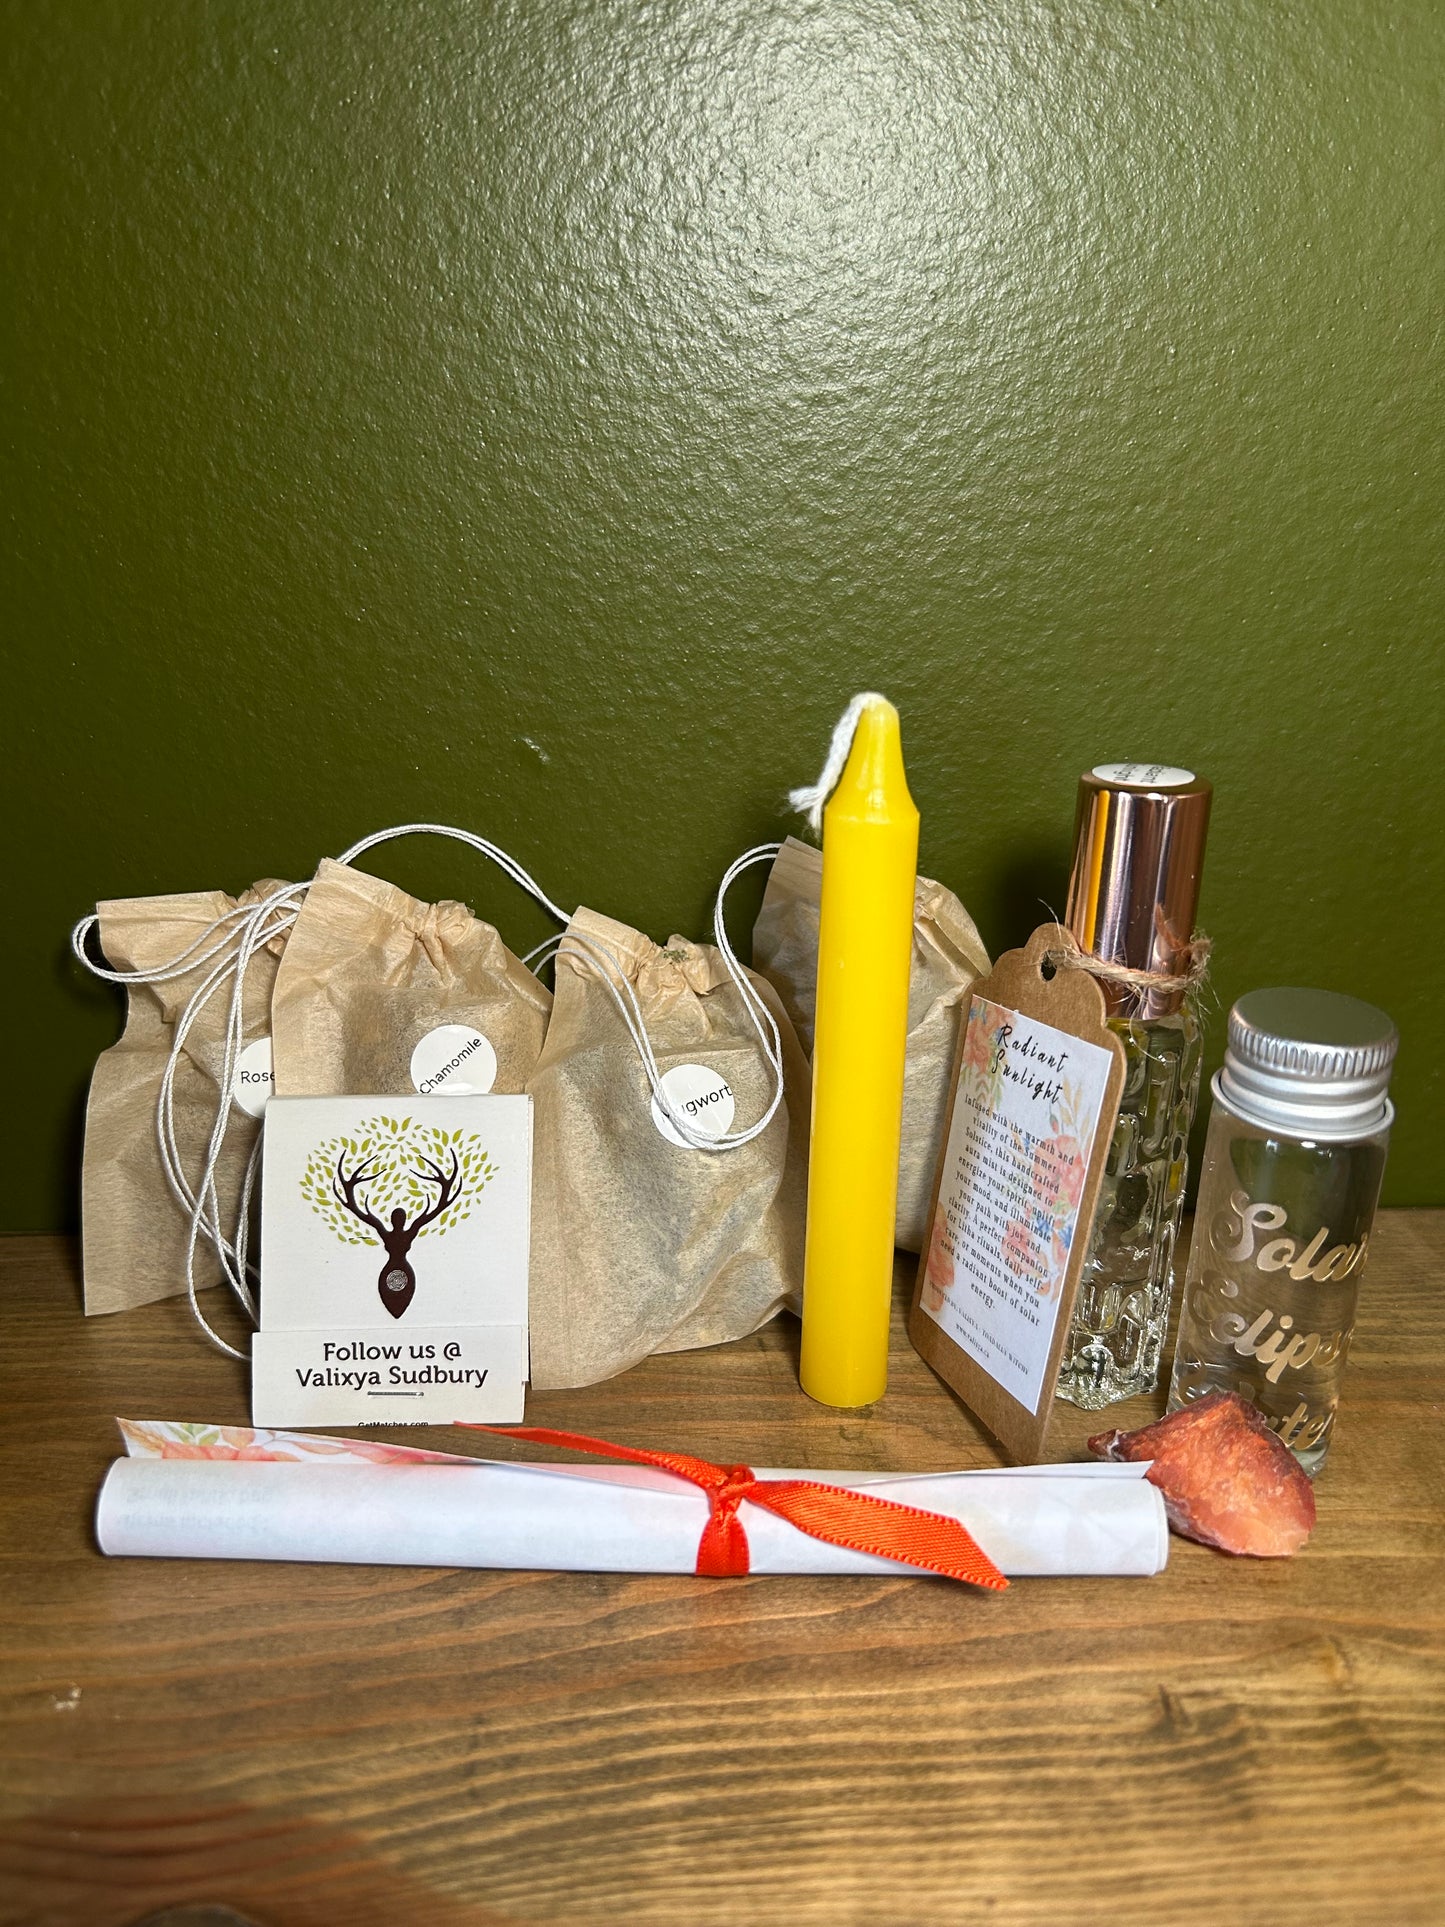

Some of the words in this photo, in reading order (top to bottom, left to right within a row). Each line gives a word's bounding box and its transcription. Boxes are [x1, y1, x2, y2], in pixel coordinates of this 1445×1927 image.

[419, 1036, 482, 1095] Chamomile
[992, 1048, 1063, 1105] Sunlight
[997, 1023, 1069, 1073] Radiant
[674, 1084, 734, 1119] gwort
[964, 1093, 990, 1116] Infused
[992, 1111, 1008, 1127] with
[1010, 1122, 1023, 1135] the
[1024, 1131, 1055, 1155] warmth
[1057, 1151, 1074, 1166] and
[973, 1116, 998, 1140] vitality
[999, 1134, 1009, 1144] of
[1009, 1138, 1022, 1152] the
[1023, 1144, 1056, 1173] Summer
[995, 1146, 1011, 1162] this
[1011, 1155, 1059, 1194] handcrafted
[958, 1156, 986, 1179] energize
[986, 1176, 1005, 1193] your
[1032, 1201, 1055, 1226] uplift
[965, 1144, 980, 1160] aura
[982, 1156, 998, 1171] mist
[999, 1165, 1006, 1177] is
[1008, 1171, 1041, 1200] designed
[1044, 1196, 1053, 1207] to
[955, 1170, 971, 1186] your
[994, 1198, 1008, 1213] and
[1010, 1205, 1052, 1243] illuminate
[958, 1189, 975, 1205] your
[975, 1201, 991, 1218] path
[993, 1214, 1010, 1232] with
[1010, 1226, 1024, 1243] joy
[1025, 1238, 1041, 1254] and
[946, 1209, 957, 1224] for
[958, 1218, 975, 1239] Litha
[1004, 1255, 1024, 1279] daily
[979, 1221, 1005, 1245] perfect
[1006, 1242, 1048, 1278] companion
[961, 1240, 969, 1251] or
[970, 1248, 1001, 1277] moments
[1003, 1273, 1023, 1295] when
[1023, 1291, 1039, 1308] you
[962, 1257, 987, 1283] radiant
[988, 1276, 1007, 1300] boost
[1009, 1297, 1019, 1309] of
[1019, 1305, 1040, 1326] solar
[296, 1367, 381, 1390] Valixya
[389, 1365, 489, 1388] Sudbury
[323, 1342, 402, 1361] Follow
[409, 1345, 436, 1359] us
[443, 1342, 462, 1361] @
